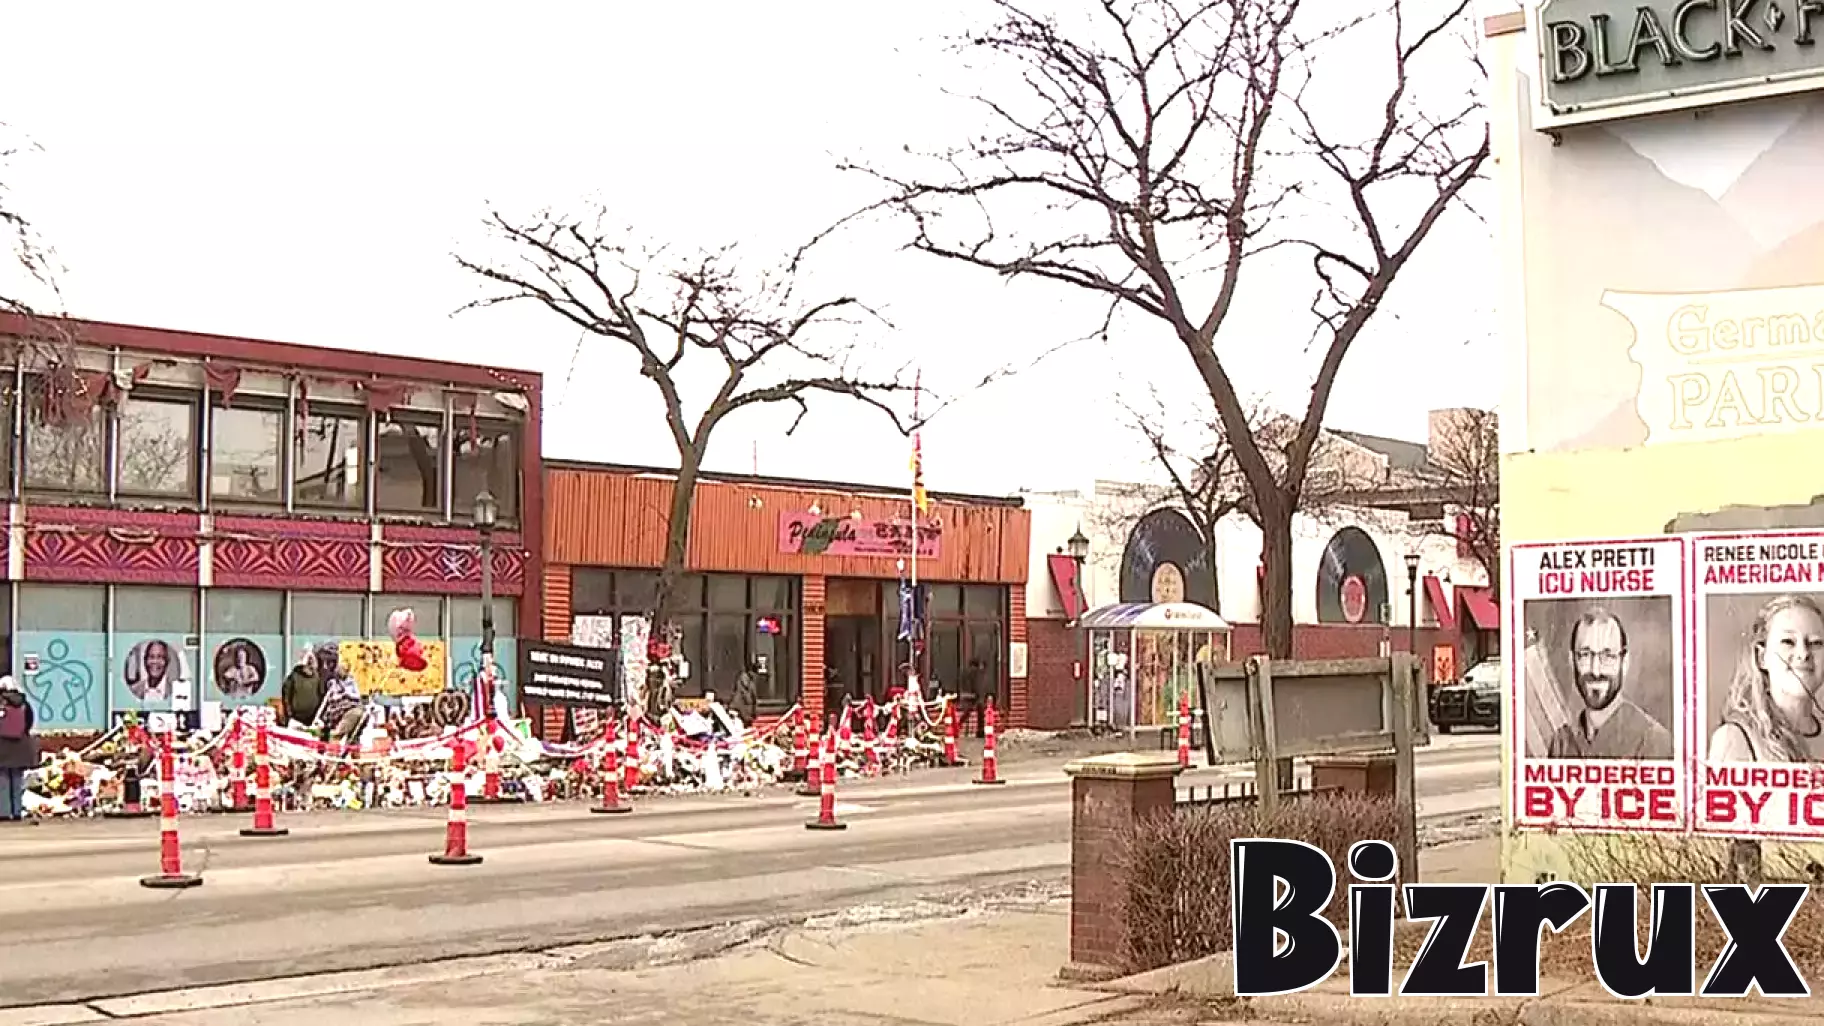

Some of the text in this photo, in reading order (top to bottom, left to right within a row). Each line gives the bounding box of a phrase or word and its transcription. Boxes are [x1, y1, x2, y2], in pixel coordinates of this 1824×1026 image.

[1547, 0, 1775, 83] BLACK
[1666, 365, 1824, 430] PAR
[1539, 547, 1655, 570] ALEX PRETTI
[1704, 543, 1819, 562] RENEE NICOLE
[1539, 569, 1655, 594] ICU NURSE
[1704, 562, 1813, 585] AMERICAN
[1525, 764, 1675, 785] MURDERED
[1525, 786, 1676, 821] BY ICE
[1705, 789, 1772, 824] BY
